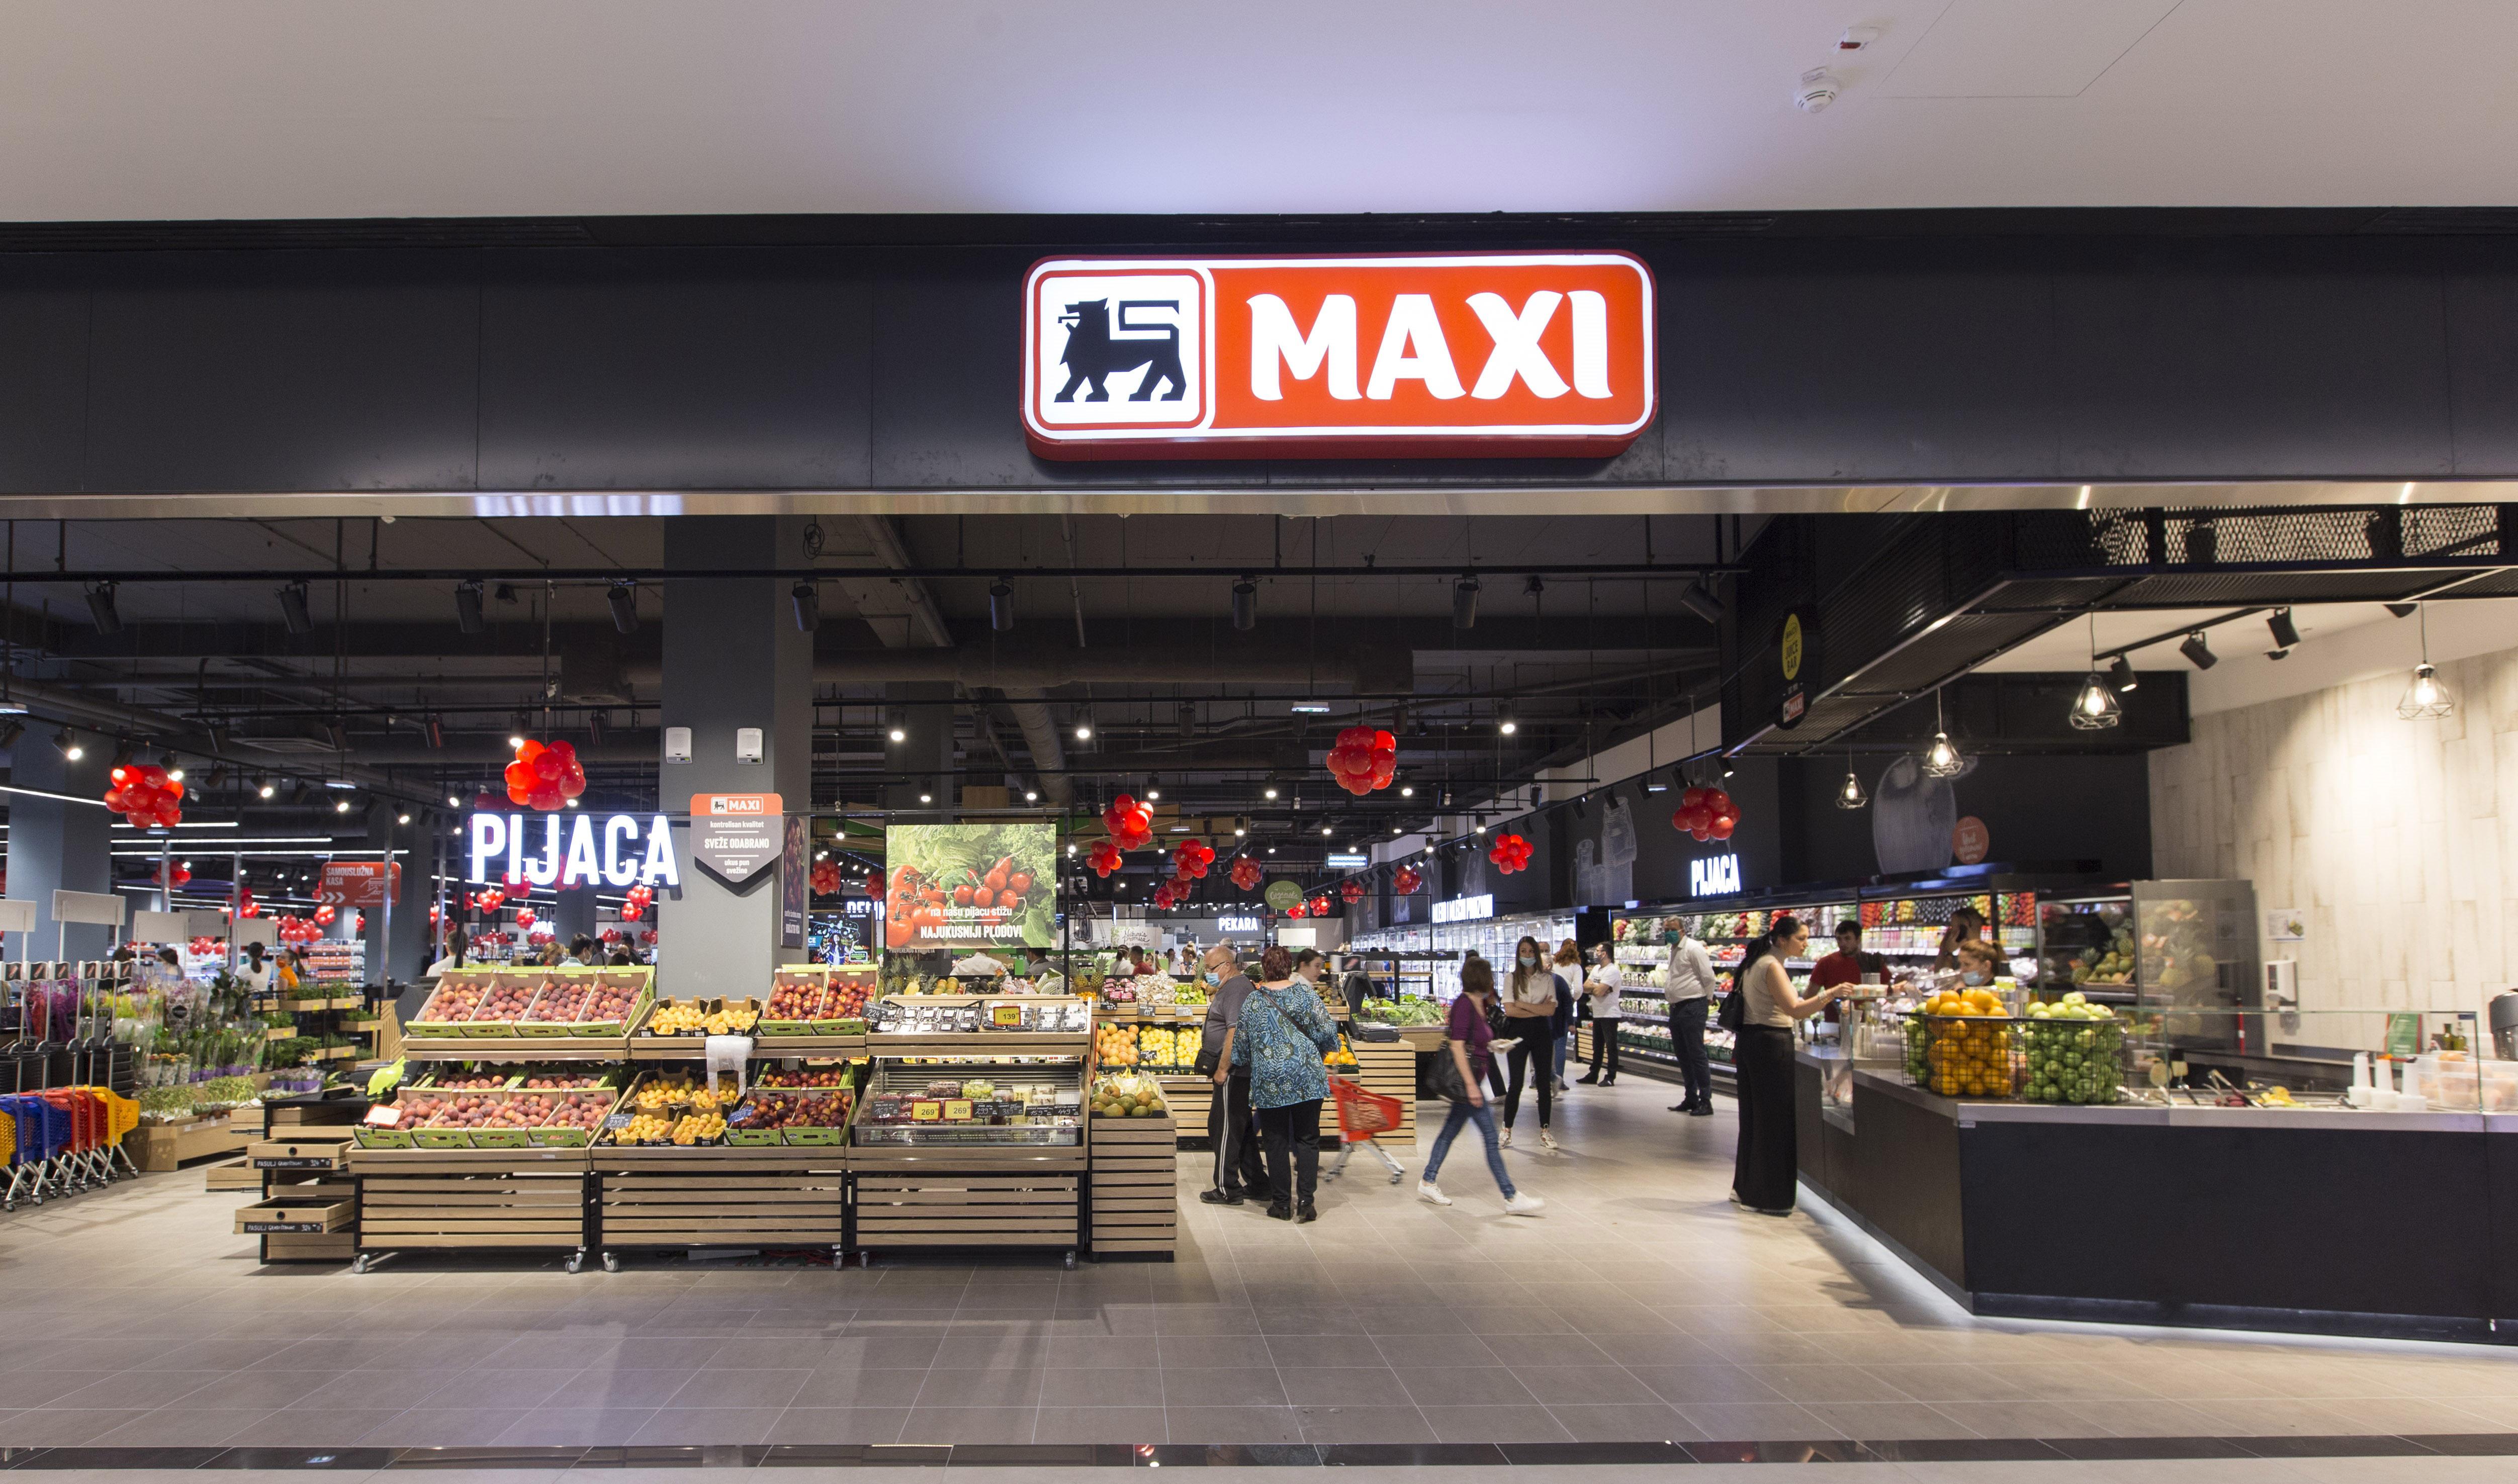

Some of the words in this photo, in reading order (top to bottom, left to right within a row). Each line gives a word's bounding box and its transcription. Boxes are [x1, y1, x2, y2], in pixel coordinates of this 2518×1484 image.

[1245, 290, 1613, 401] MAXI
[729, 800, 760, 811] MAXI
[704, 837, 729, 849] SVEŽE
[730, 838, 769, 849] ODABRANO
[472, 813, 679, 886] PIJACA
[326, 865, 374, 876] SAMOUSLUŽNA
[1691, 853, 1741, 897] PIJACA
[325, 876, 343, 886] KASA
[930, 908, 941, 917] na
[942, 906, 963, 917] našu
[964, 906, 990, 918] pijacu
[991, 905, 1013, 916] stižu
[1218, 917, 1258, 931] PEKARA
[920, 925, 981, 939] NAJUKUSNIJI
[983, 925, 1023, 938] PLODOVI
[866, 1009, 880, 1017] 224
[606, 1119, 622, 1127] 239
